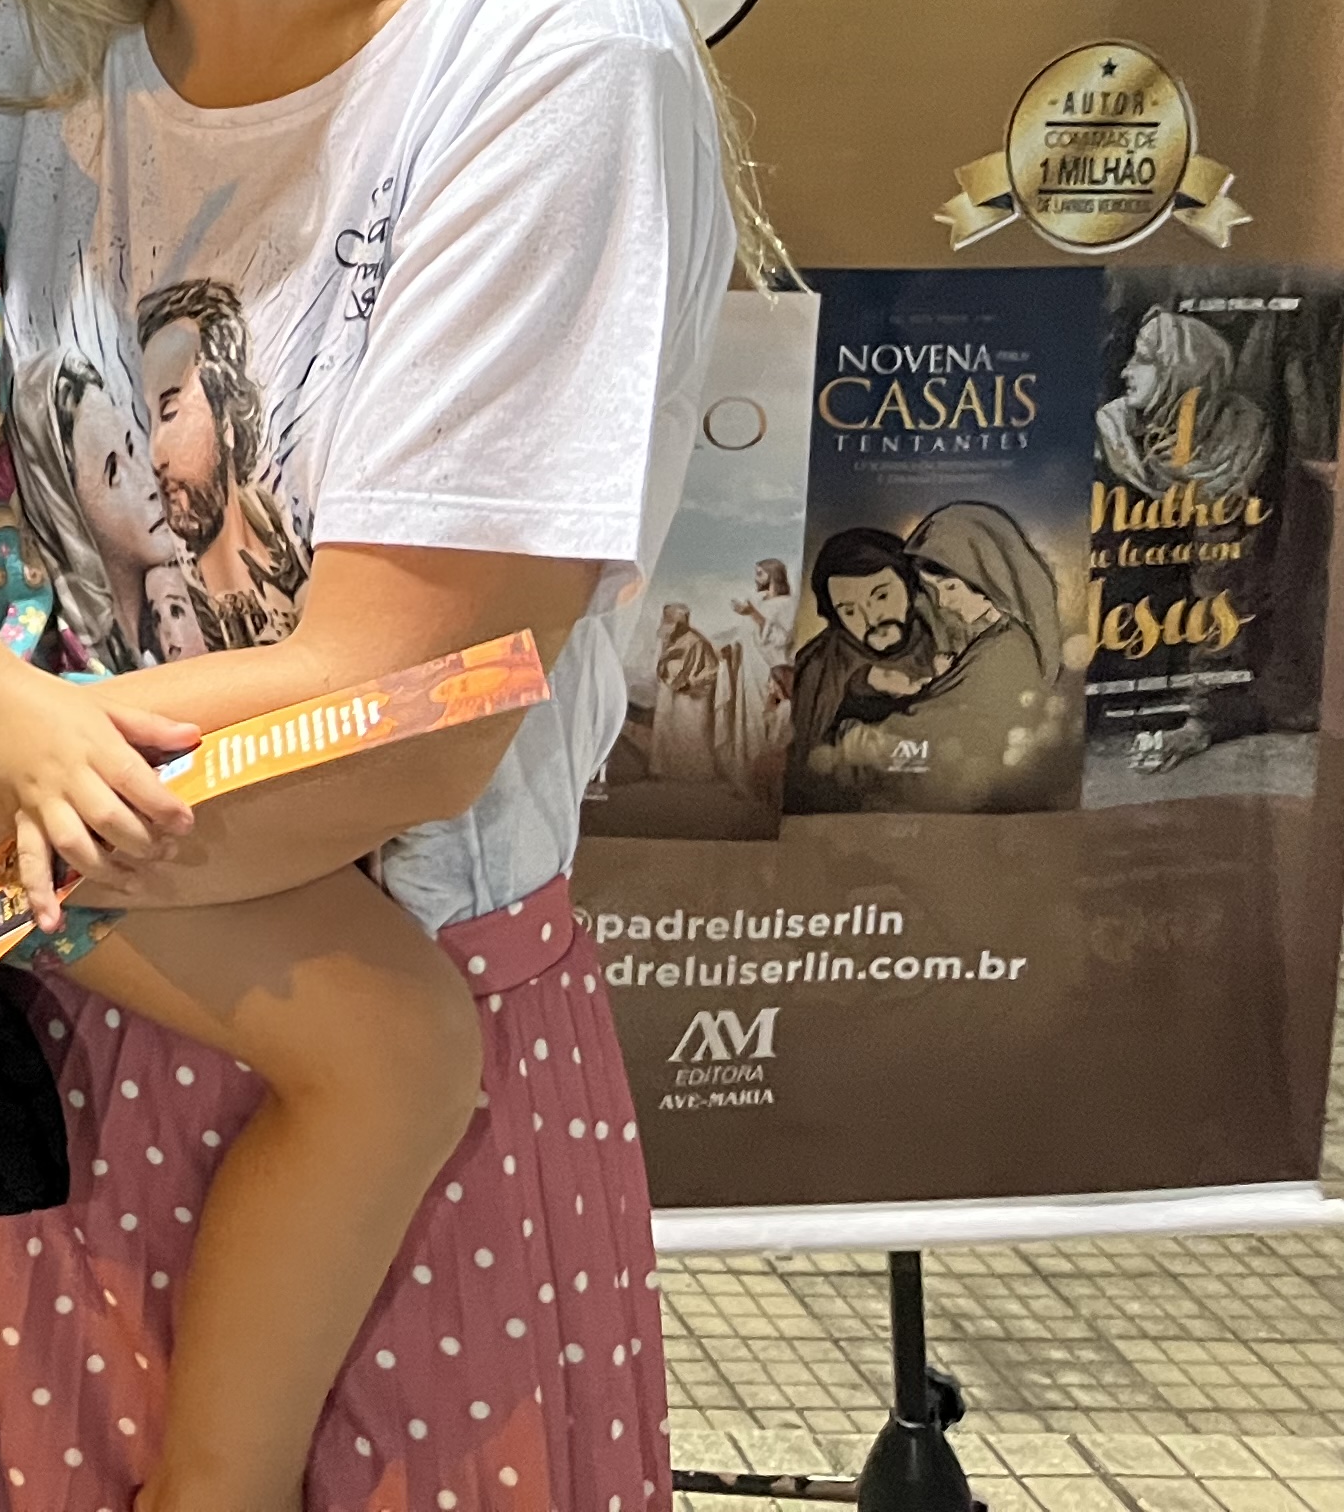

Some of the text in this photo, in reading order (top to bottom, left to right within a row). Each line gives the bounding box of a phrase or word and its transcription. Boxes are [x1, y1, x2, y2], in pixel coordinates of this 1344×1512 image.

[1063, 91, 1145, 115] AUTOR
[1040, 150, 1156, 186] 1 MILHÃO
[838, 344, 993, 375] NOVENA
[818, 373, 1037, 430] CASAIS
[834, 434, 1029, 453] TENTANTES
[1087, 576, 1256, 661] Jesus
[675, 1065, 764, 1086] EDITORA
[659, 1090, 775, 1110] AVE-MARIA
